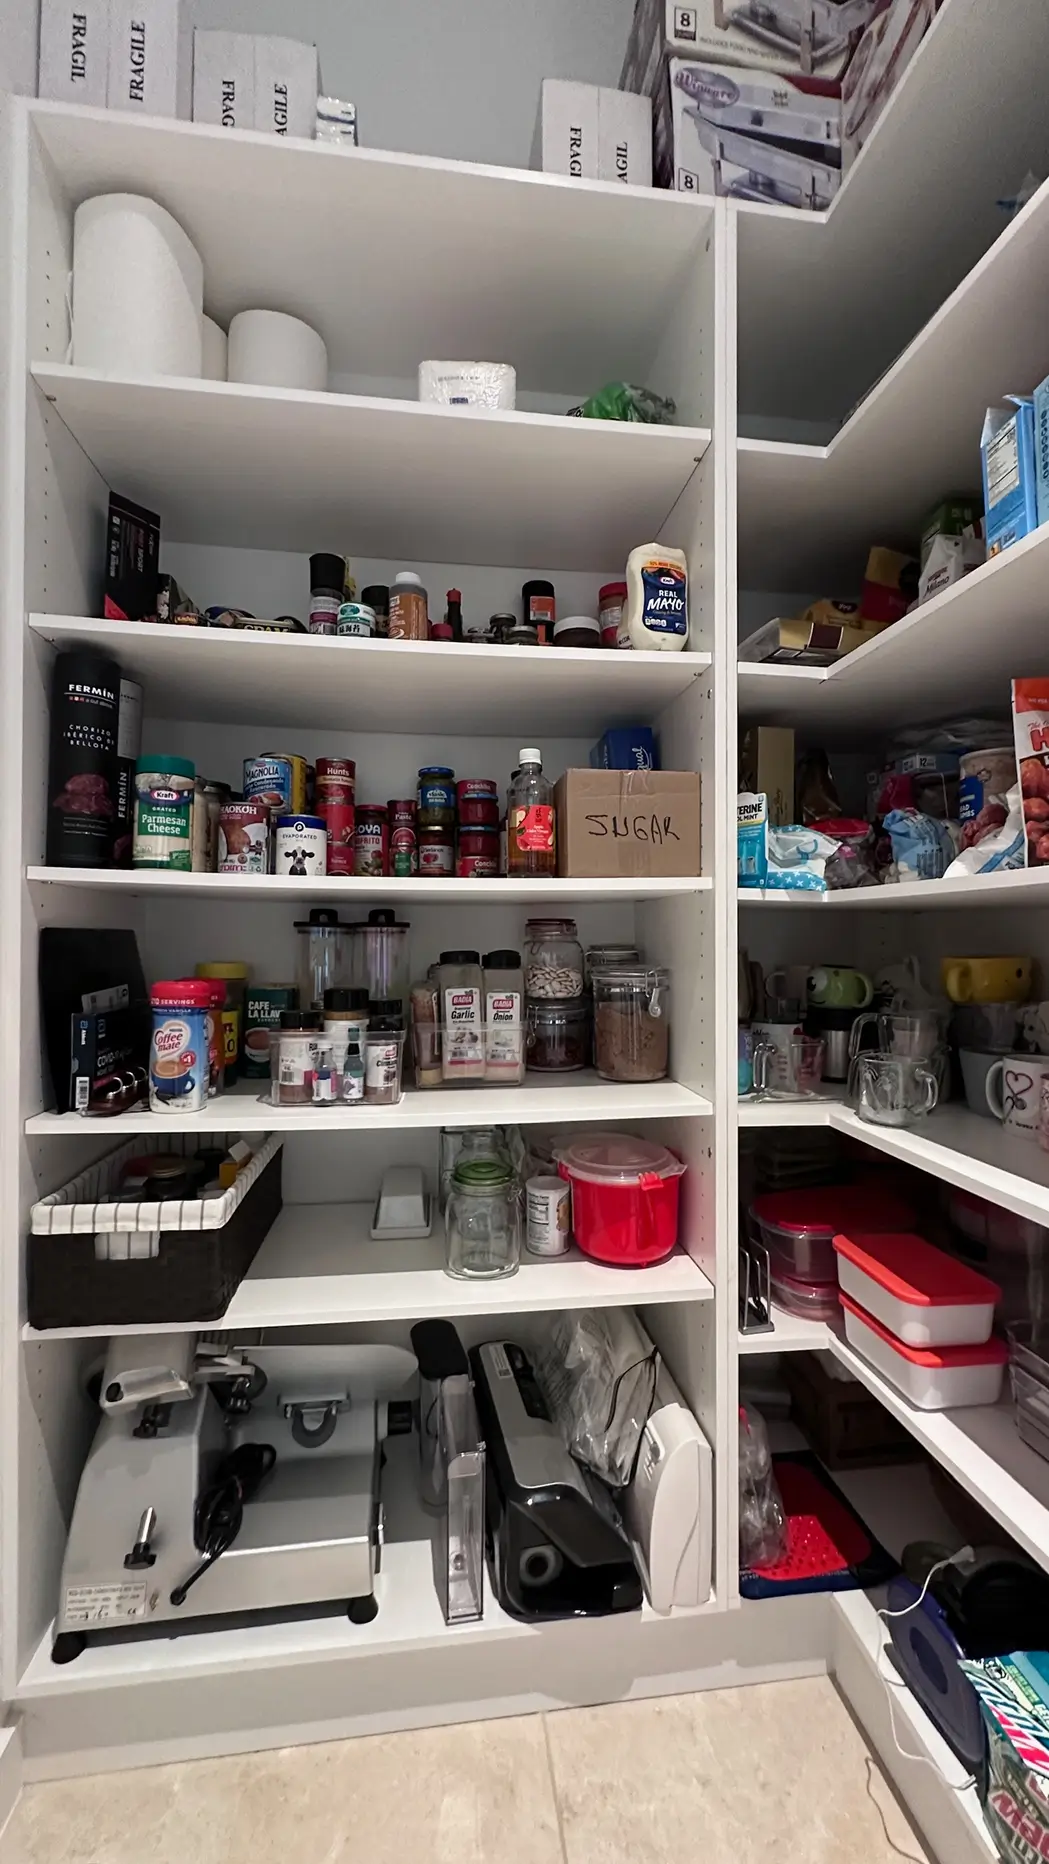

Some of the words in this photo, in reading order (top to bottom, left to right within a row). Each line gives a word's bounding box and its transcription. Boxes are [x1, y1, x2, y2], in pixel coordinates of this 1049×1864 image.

[680, 13, 691, 27] 8
[129, 20, 146, 102] FRAGILE
[222, 80, 235, 128] FRAG
[274, 84, 287, 136] AGILE
[570, 126, 582, 178] FRAGI
[684, 175, 694, 190] 8
[658, 590, 677, 598] REAL
[647, 598, 684, 611] MAYO
[68, 683, 114, 700] FERMÍN
[69, 724, 111, 737] CHORIZO
[70, 740, 109, 751] BELLOTA
[632, 745, 649, 770] qual
[245, 766, 279, 781] MAGNOLIA
[118, 772, 128, 818] FERMÍN
[156, 791, 174, 799] Kraft
[220, 805, 257, 815] AOKOH
[737, 803, 763, 815] TERINE
[142, 814, 187, 827] Parmesan
[743, 813, 758, 821] MINT
[147, 823, 181, 835] Cheese
[356, 825, 381, 834] OYA
[585, 814, 680, 844] SUGAR
[355, 837, 380, 845] FRITO
[248, 1001, 270, 1010] CAFE
[453, 995, 473, 1004] BADIA
[493, 999, 513, 1008] BADIA
[248, 1010, 259, 1018] LA
[260, 1010, 284, 1018] LLAV
[451, 1010, 475, 1020] Garlic
[493, 1012, 514, 1021] Onion
[154, 1030, 184, 1047] Coffee
[157, 1041, 181, 1052] mate
